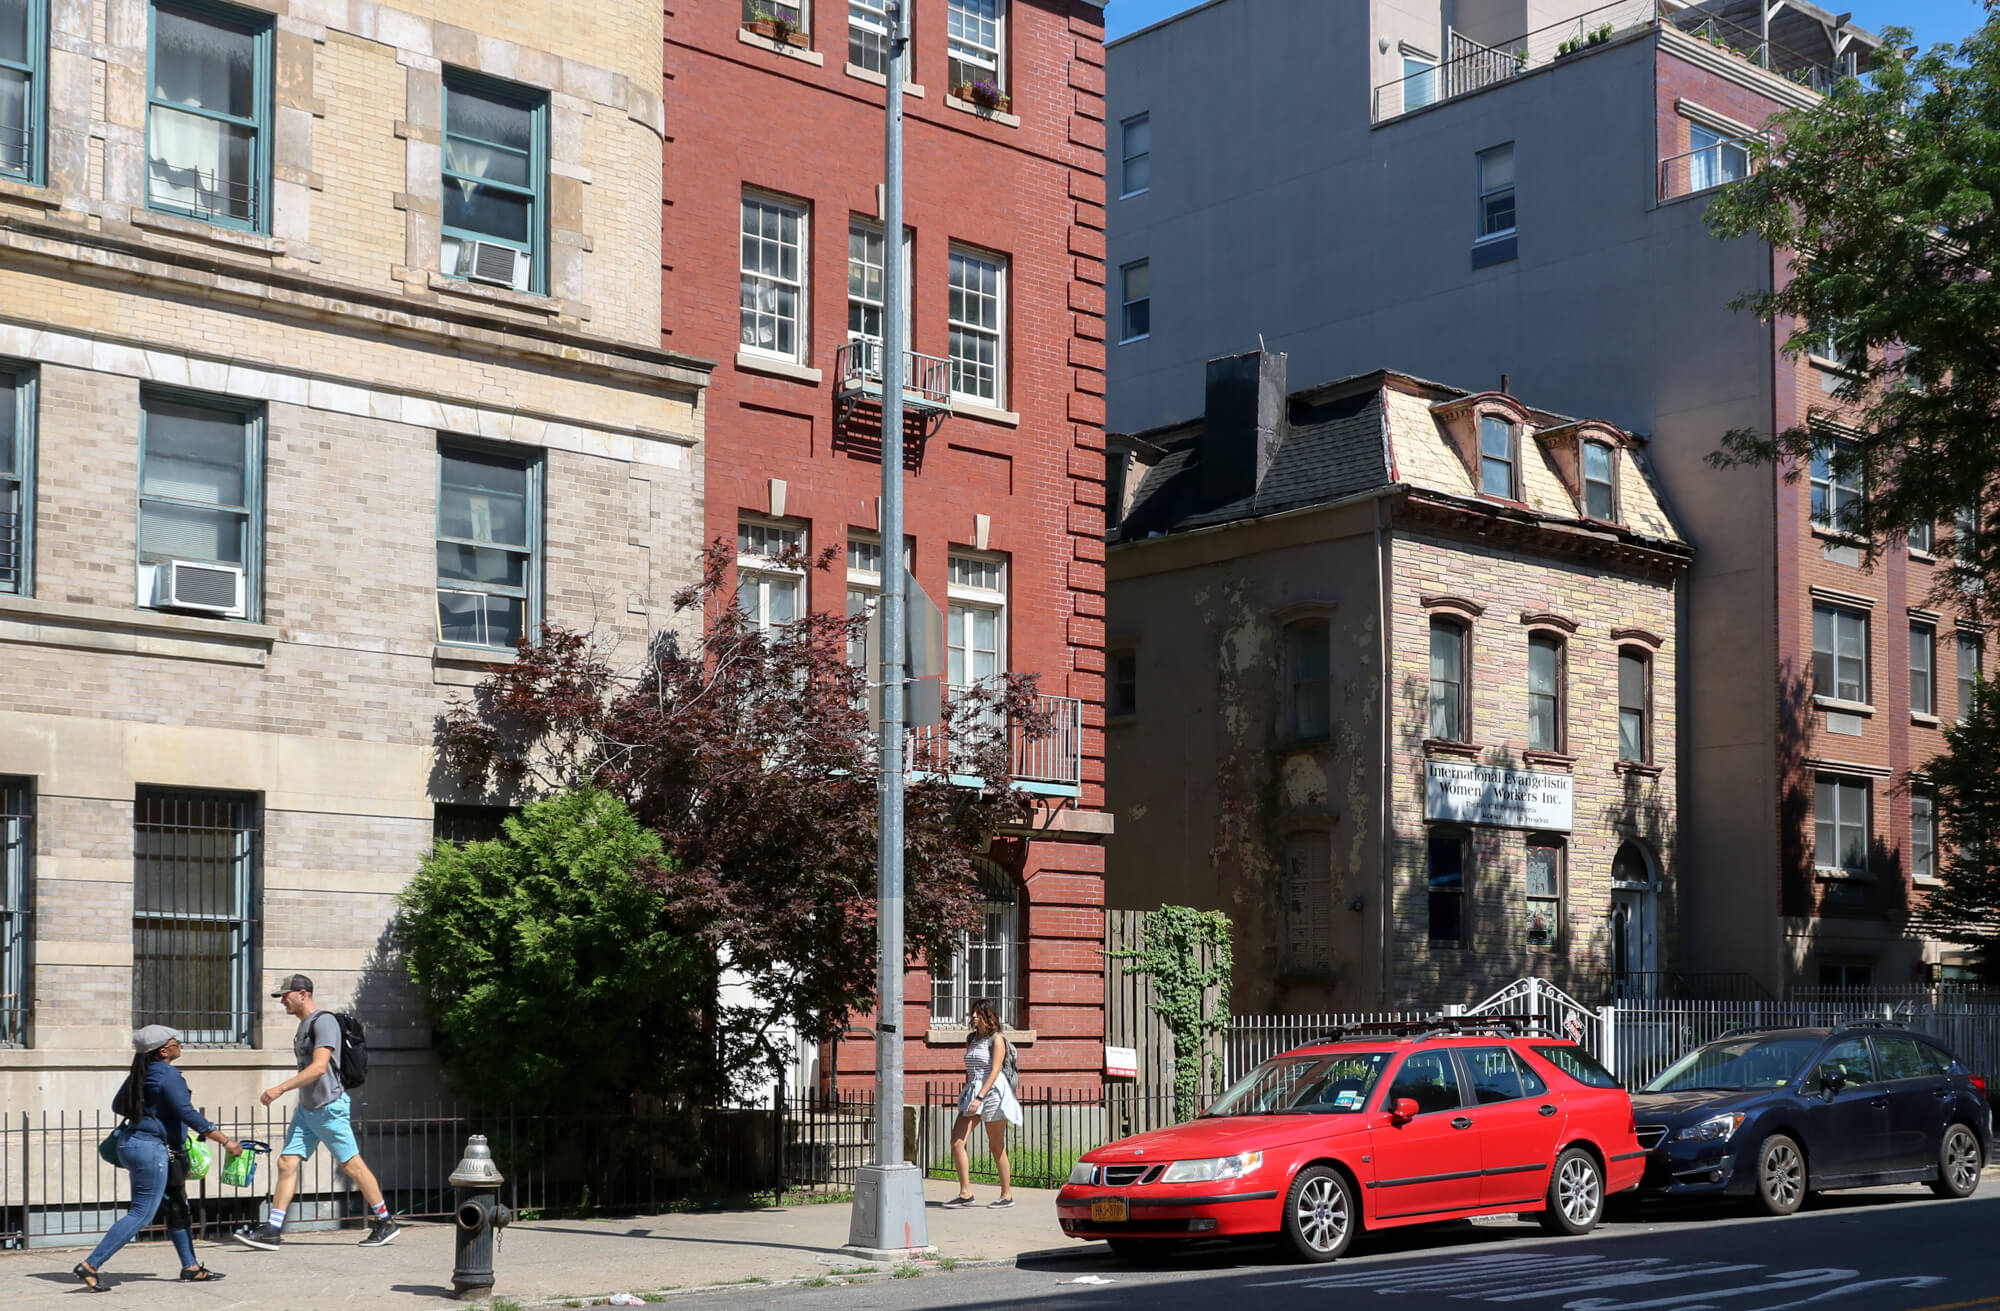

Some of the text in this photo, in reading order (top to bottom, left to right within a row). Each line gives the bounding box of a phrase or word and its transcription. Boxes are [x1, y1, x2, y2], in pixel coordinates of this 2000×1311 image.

[1429, 765, 1569, 790] International Evangelistic
[1440, 782, 1561, 804] Women Workers Inc.
